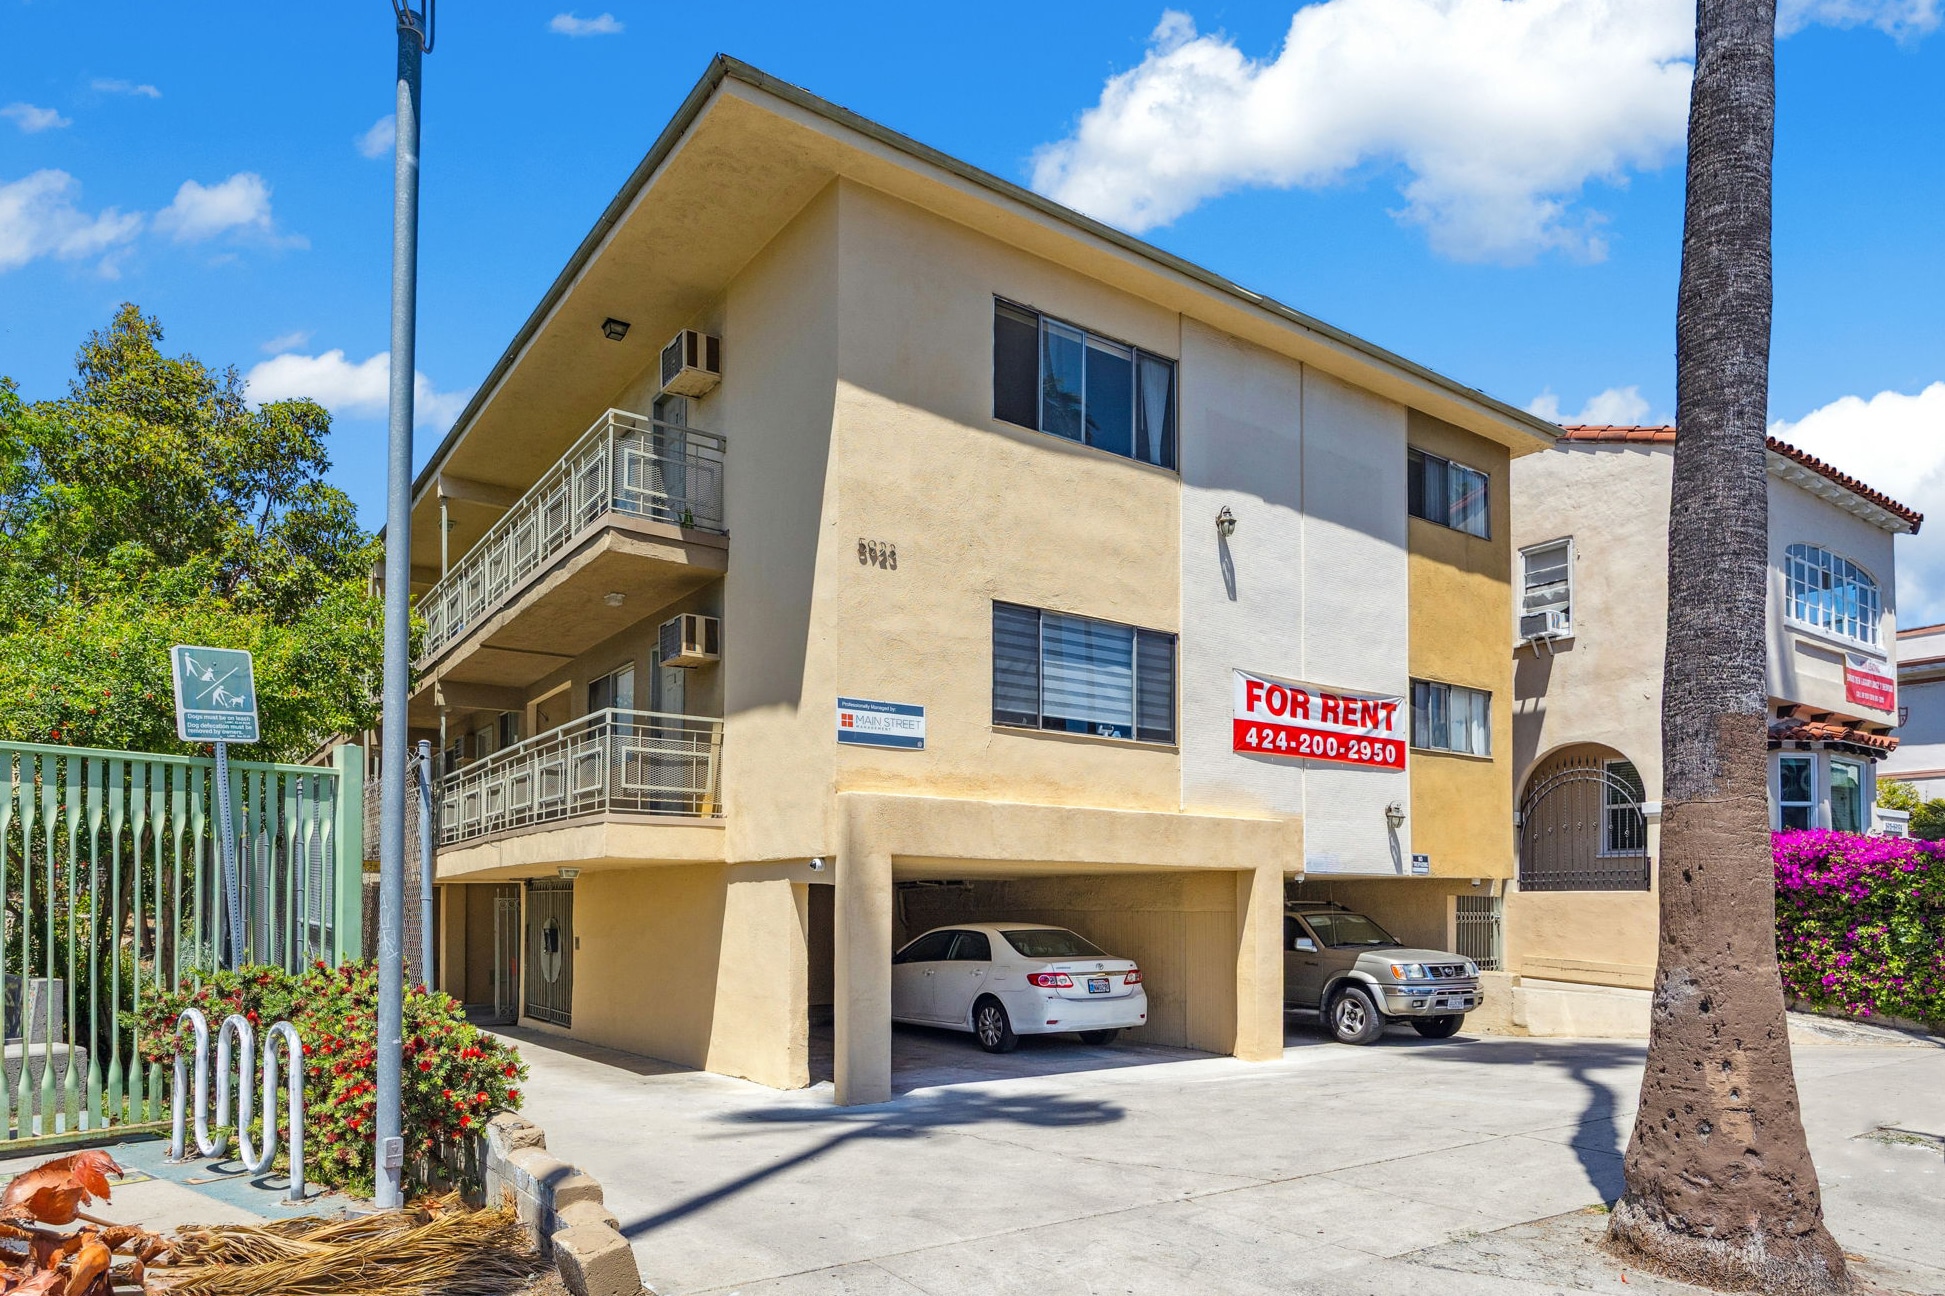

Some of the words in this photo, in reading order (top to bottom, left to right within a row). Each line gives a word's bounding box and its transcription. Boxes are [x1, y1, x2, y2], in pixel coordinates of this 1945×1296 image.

[841, 701, 870, 710] Professionally
[871, 704, 889, 712] Managed
[1245, 679, 1310, 721] FOR
[1319, 692, 1398, 732] RENT
[855, 714, 882, 727] MAIN
[884, 717, 922, 730] STREET
[855, 724, 892, 732] MANAGEMENT
[1245, 727, 1397, 763] 424-200-2950
